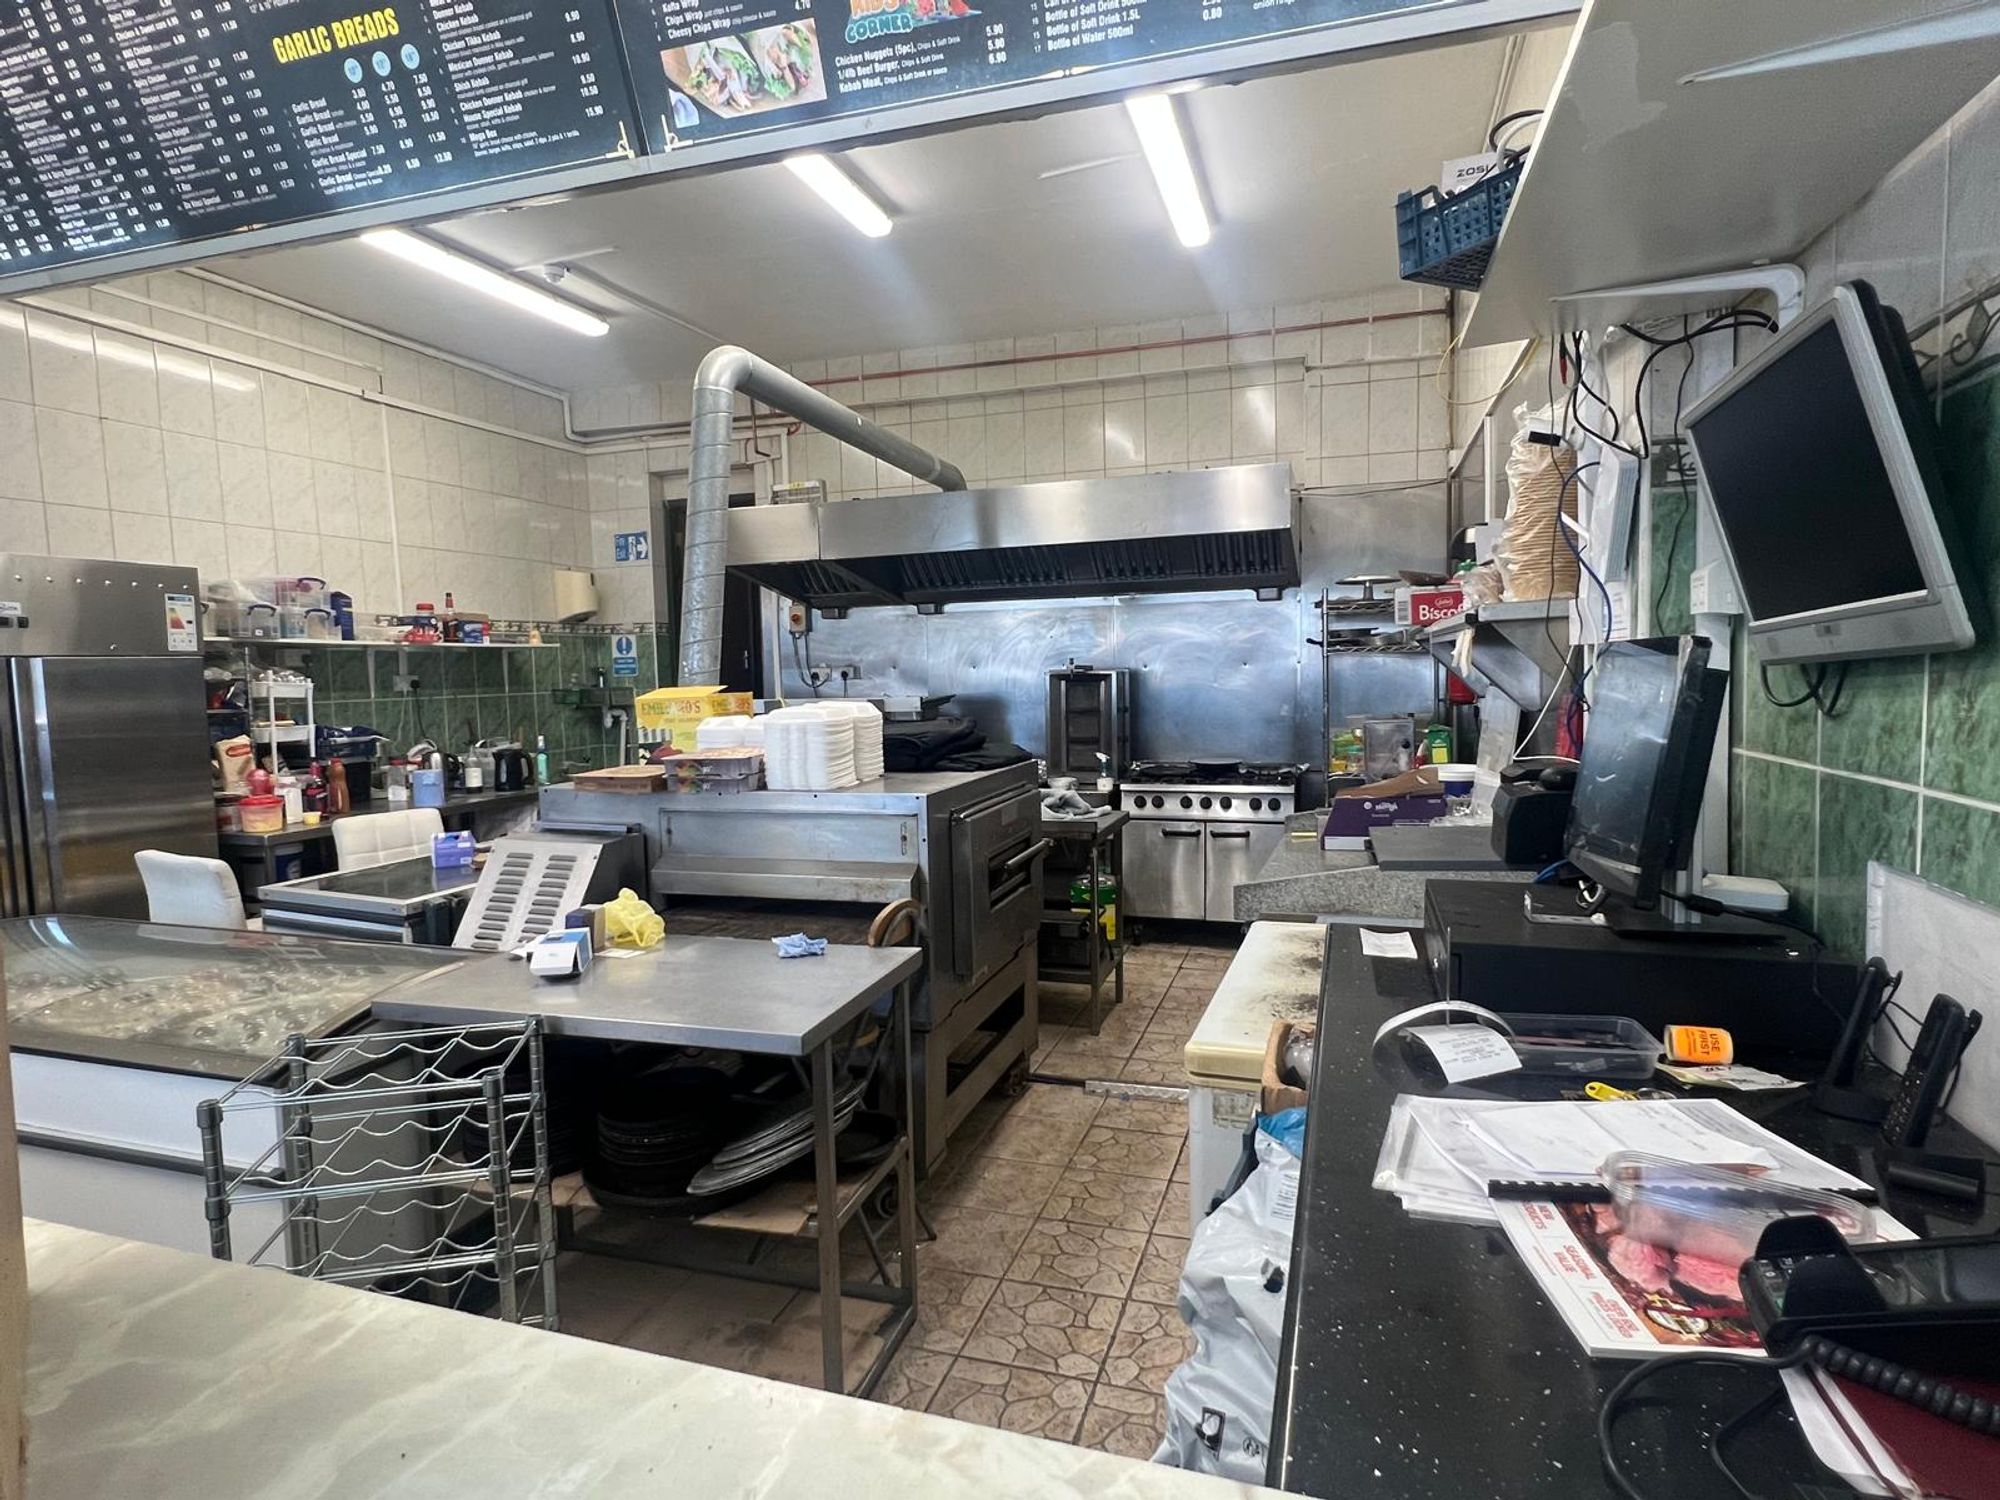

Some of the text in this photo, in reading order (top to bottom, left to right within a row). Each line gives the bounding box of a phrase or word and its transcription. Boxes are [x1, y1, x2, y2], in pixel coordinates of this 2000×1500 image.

[454, 1, 474, 14] Kebab
[1045, 0, 1120, 23] Bottle of Soft Drink
[1202, 8, 1222, 22] 0.80
[436, 18, 460, 32] Chicken
[460, 14, 479, 26] Kebab
[665, 14, 684, 27] Chips
[684, 10, 704, 22] Wrap
[1046, 22, 1070, 38] Bottle
[1070, 19, 1079, 32] of
[1080, 16, 1098, 32] Soft
[1098, 14, 1121, 28] Drink
[1123, 10, 1141, 24] 1.5L
[272, 25, 332, 64] GARLIC
[335, 8, 400, 51] BREADS
[668, 26, 692, 40] Cheesy
[692, 22, 712, 34] Chips
[712, 17, 731, 30] Wrap
[846, 14, 912, 43] CORNER
[986, 24, 1004, 37] 5.90
[442, 40, 466, 52] Chicken
[482, 30, 502, 42] Kebab
[987, 38, 1005, 50] 5.90
[1048, 36, 1072, 51] Bottle
[1072, 32, 1080, 46] of
[1081, 29, 1106, 44] Water
[1107, 25, 1134, 40] 500ml
[494, 48, 514, 61] Kebab
[835, 52, 864, 68] Chicken
[864, 46, 894, 62] Nuggets
[948, 36, 960, 45] Drink
[988, 52, 1007, 65] 6.90
[837, 68, 857, 80] 1/4lb
[856, 64, 873, 76] Beef
[932, 53, 944, 62] Drink
[470, 76, 490, 88] Kebab
[839, 80, 862, 94] Kebab
[292, 97, 328, 114] Garlic Bread
[460, 98, 482, 112] Chicken
[504, 88, 524, 102] Kebab
[503, 102, 523, 114] Kebab
[296, 110, 332, 125] Garlic Bread
[300, 121, 336, 137] Garlic Bread
[304, 134, 340, 148] Garlic Bread
[312, 156, 330, 168] Garlic
[328, 152, 346, 164] Bread
[1456, 164, 1489, 178] ZOSI
[318, 174, 336, 188] Garlic
[336, 172, 354, 184] Bread
[1699, 1030, 1710, 1056] FIRST
[1710, 1033, 1720, 1052] USE
[1563, 1244, 1597, 1280] SEASONAL
